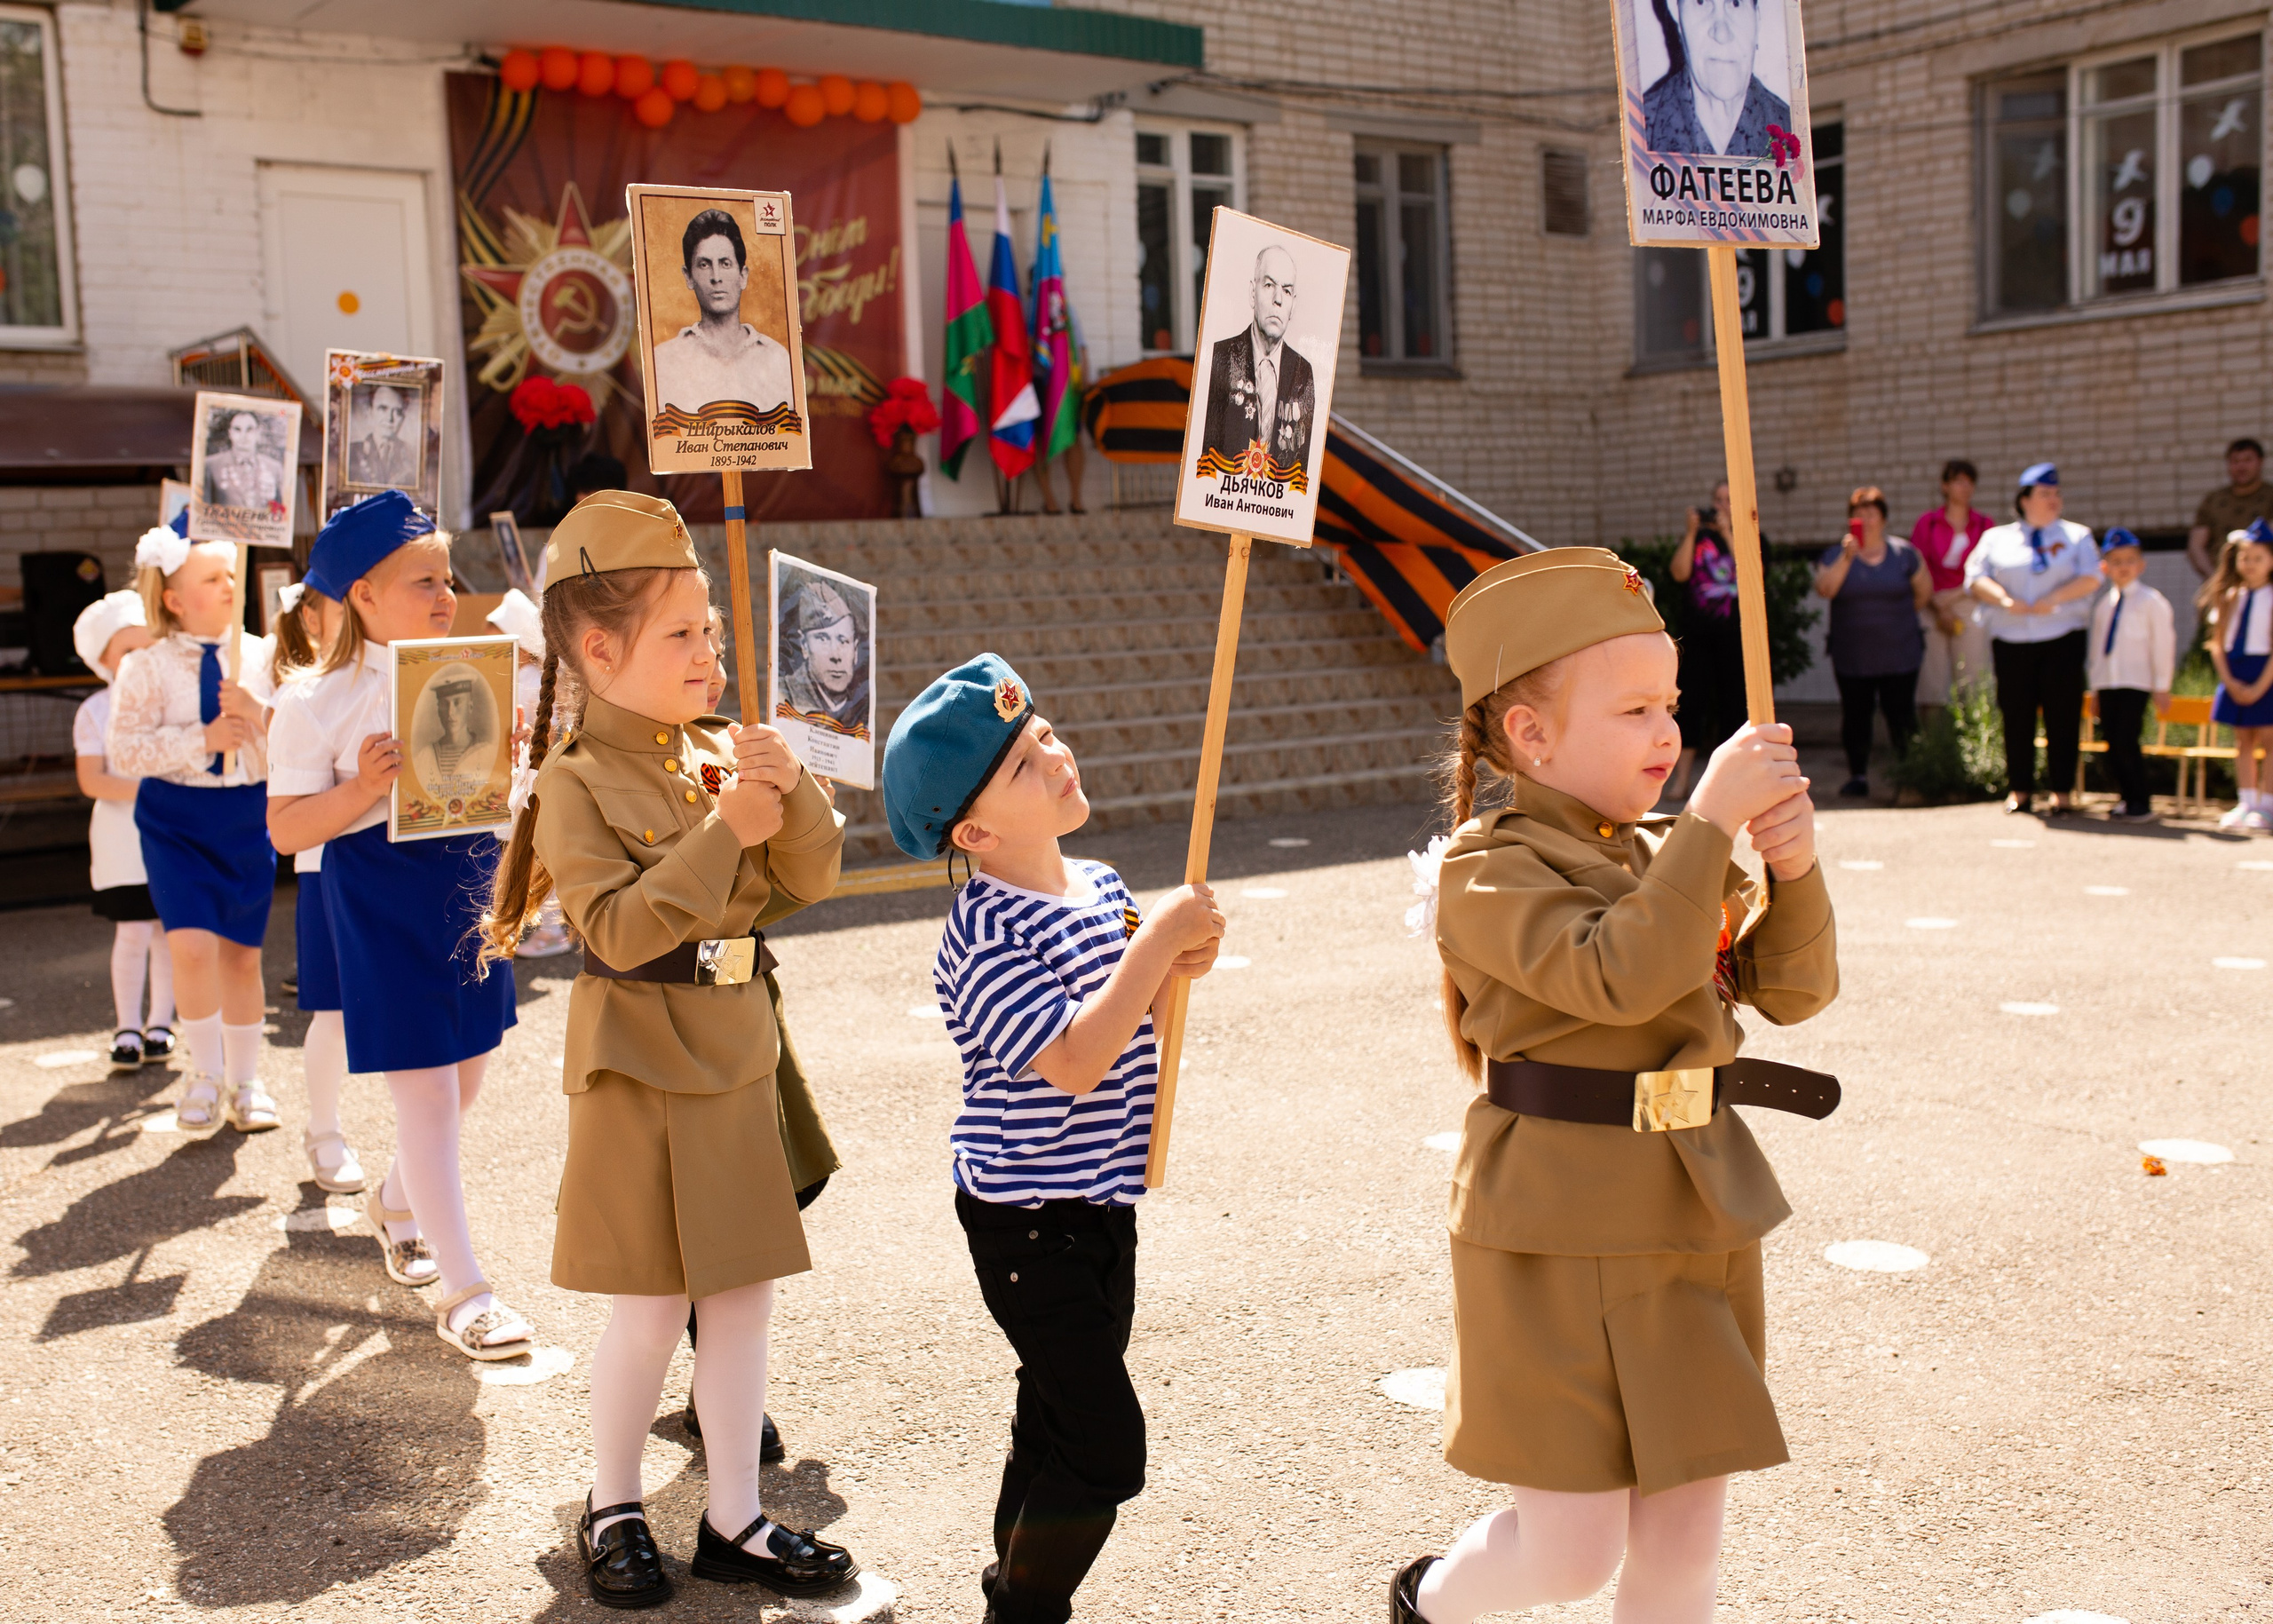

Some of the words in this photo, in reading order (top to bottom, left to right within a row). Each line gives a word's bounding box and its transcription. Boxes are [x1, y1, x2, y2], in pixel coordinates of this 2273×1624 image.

[1650, 163, 1797, 205] ФАТЕЕВА
[1643, 209, 1697, 226] МАРФА
[1700, 210, 1810, 230] ЕВДОКИМОВНА
[2112, 197, 2145, 246] 9
[686, 421, 775, 440] Ширыкалов
[676, 440, 709, 454] Иван
[712, 440, 788, 454] Степанович
[709, 456, 757, 467] 1895-1942
[1220, 475, 1284, 498] ДЬЯЧКОВ
[1205, 493, 1233, 510] Иван
[1236, 498, 1294, 519] Антонович
